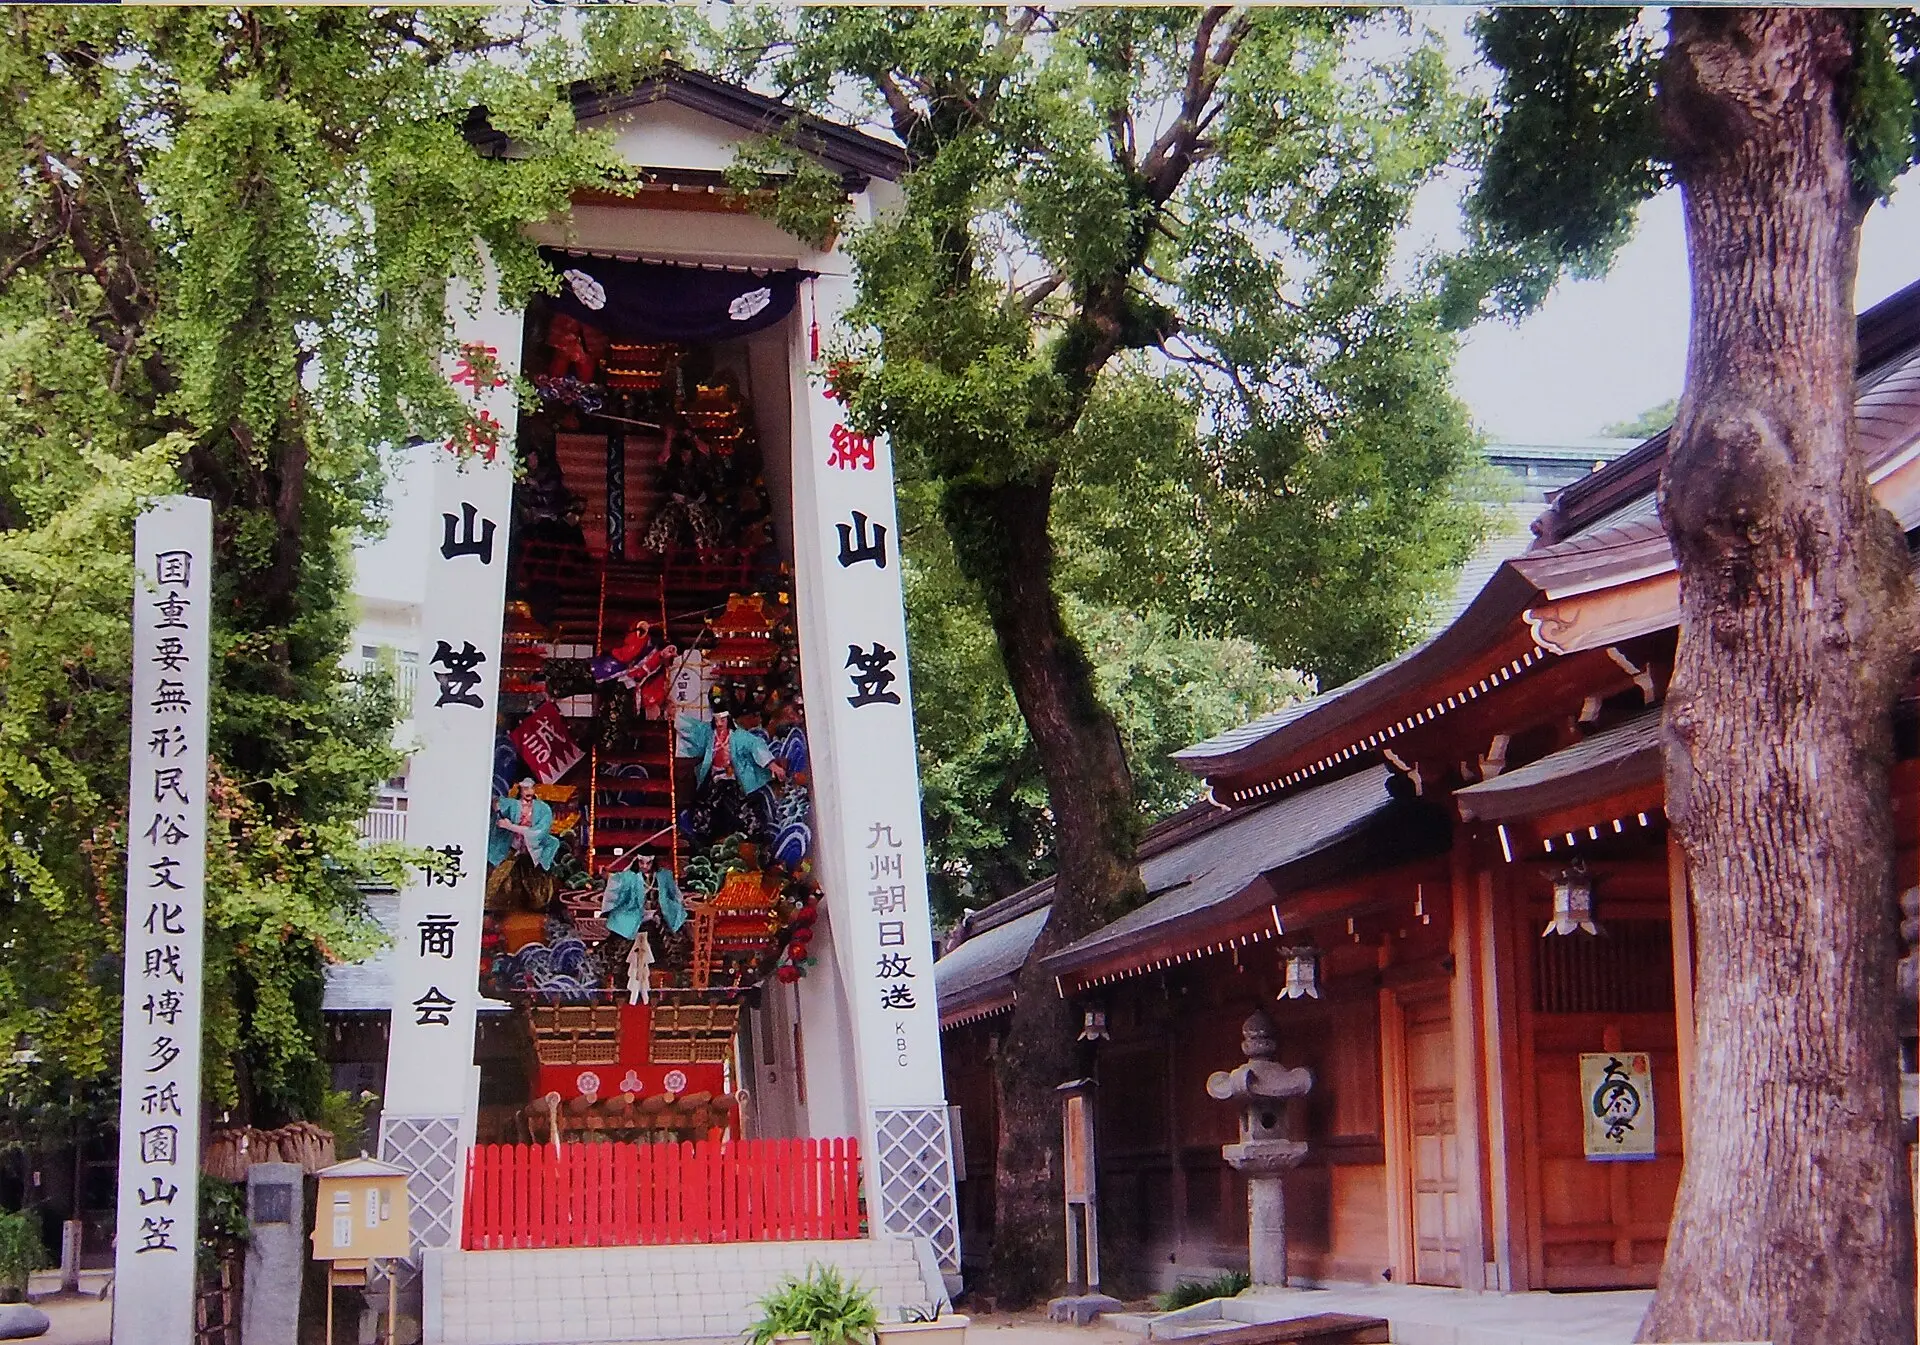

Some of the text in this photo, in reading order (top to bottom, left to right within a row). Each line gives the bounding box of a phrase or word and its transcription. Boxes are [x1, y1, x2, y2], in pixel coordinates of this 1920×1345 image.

[522, 716, 567, 764] 誠
[866, 822, 917, 1010] 九州朝日放送
[895, 1021, 908, 1067] KBC
